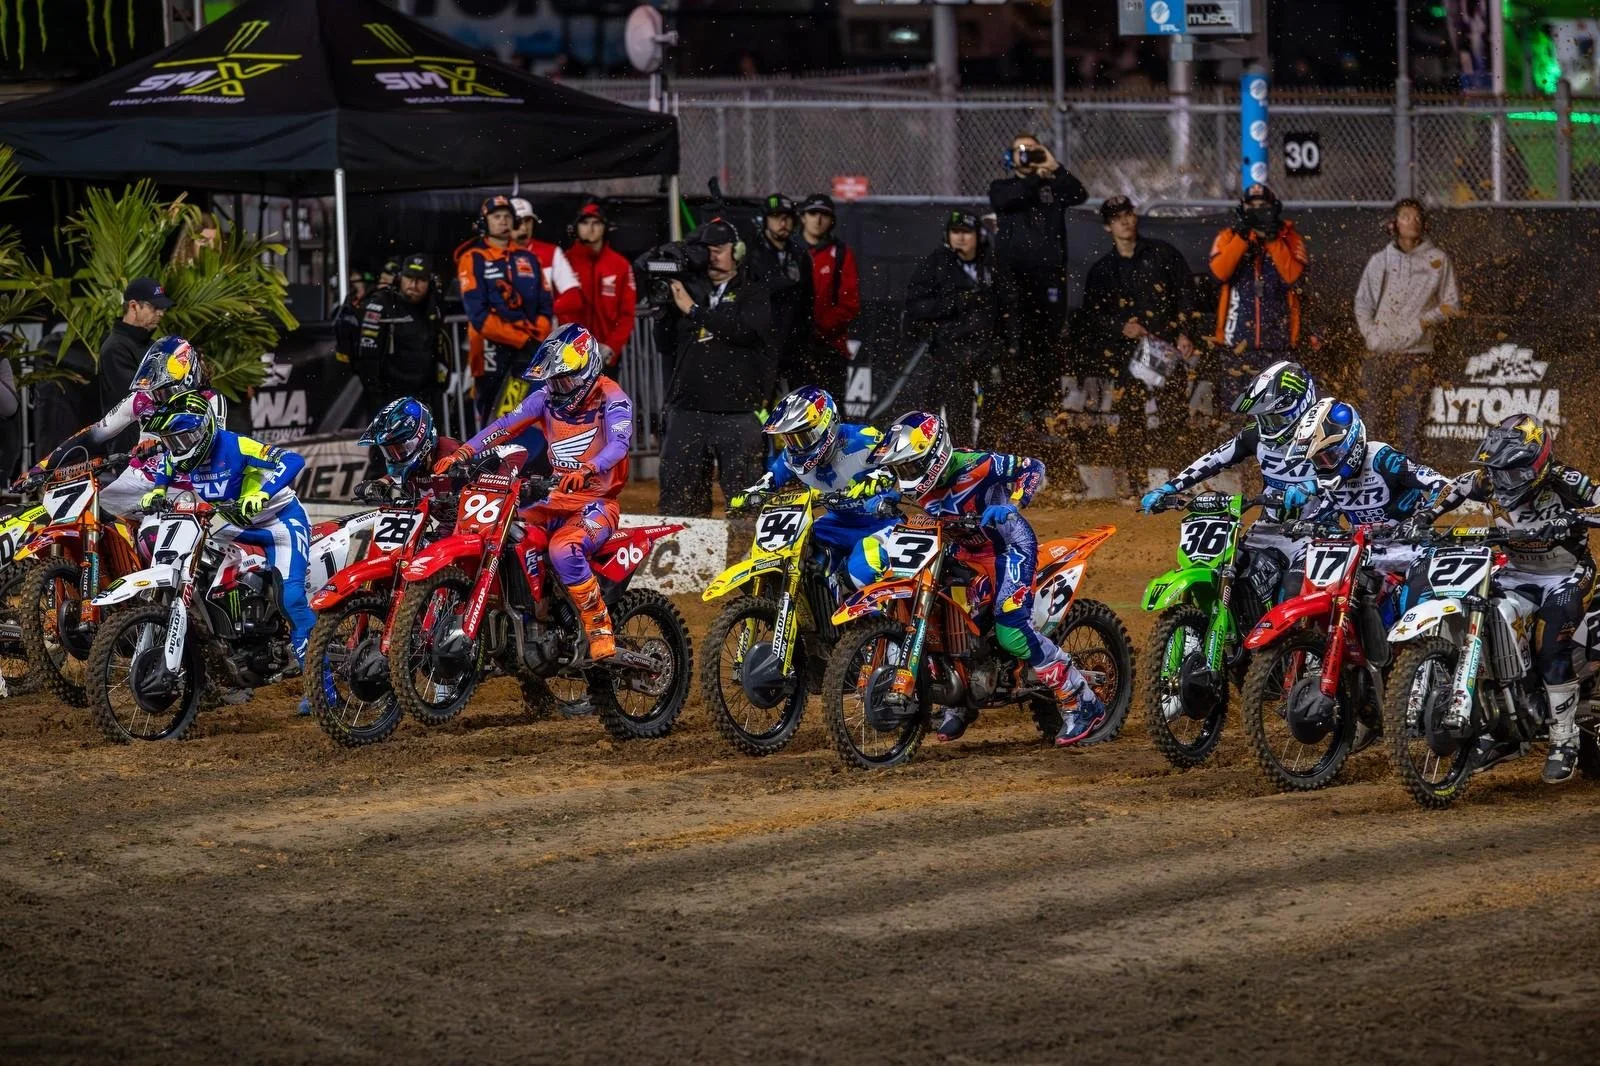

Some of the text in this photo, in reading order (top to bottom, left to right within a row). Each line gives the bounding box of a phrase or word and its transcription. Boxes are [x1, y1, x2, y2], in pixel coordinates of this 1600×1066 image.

[127, 62, 284, 96] SMX
[375, 64, 510, 97] SMX
[1285, 141, 1320, 170] 30
[51, 482, 88, 520] 7
[193, 479, 229, 498] FLY
[462, 493, 503, 524] 96
[160, 521, 182, 549] 1
[374, 517, 416, 544] 28
[759, 513, 799, 543] 94
[1181, 521, 1231, 556] 36
[616, 543, 644, 571] 96
[887, 536, 935, 569] 3
[1310, 551, 1350, 580] 17
[1429, 557, 1488, 587] 27
[467, 587, 486, 633] DUNLOP
[168, 610, 182, 656] DUNLOP
